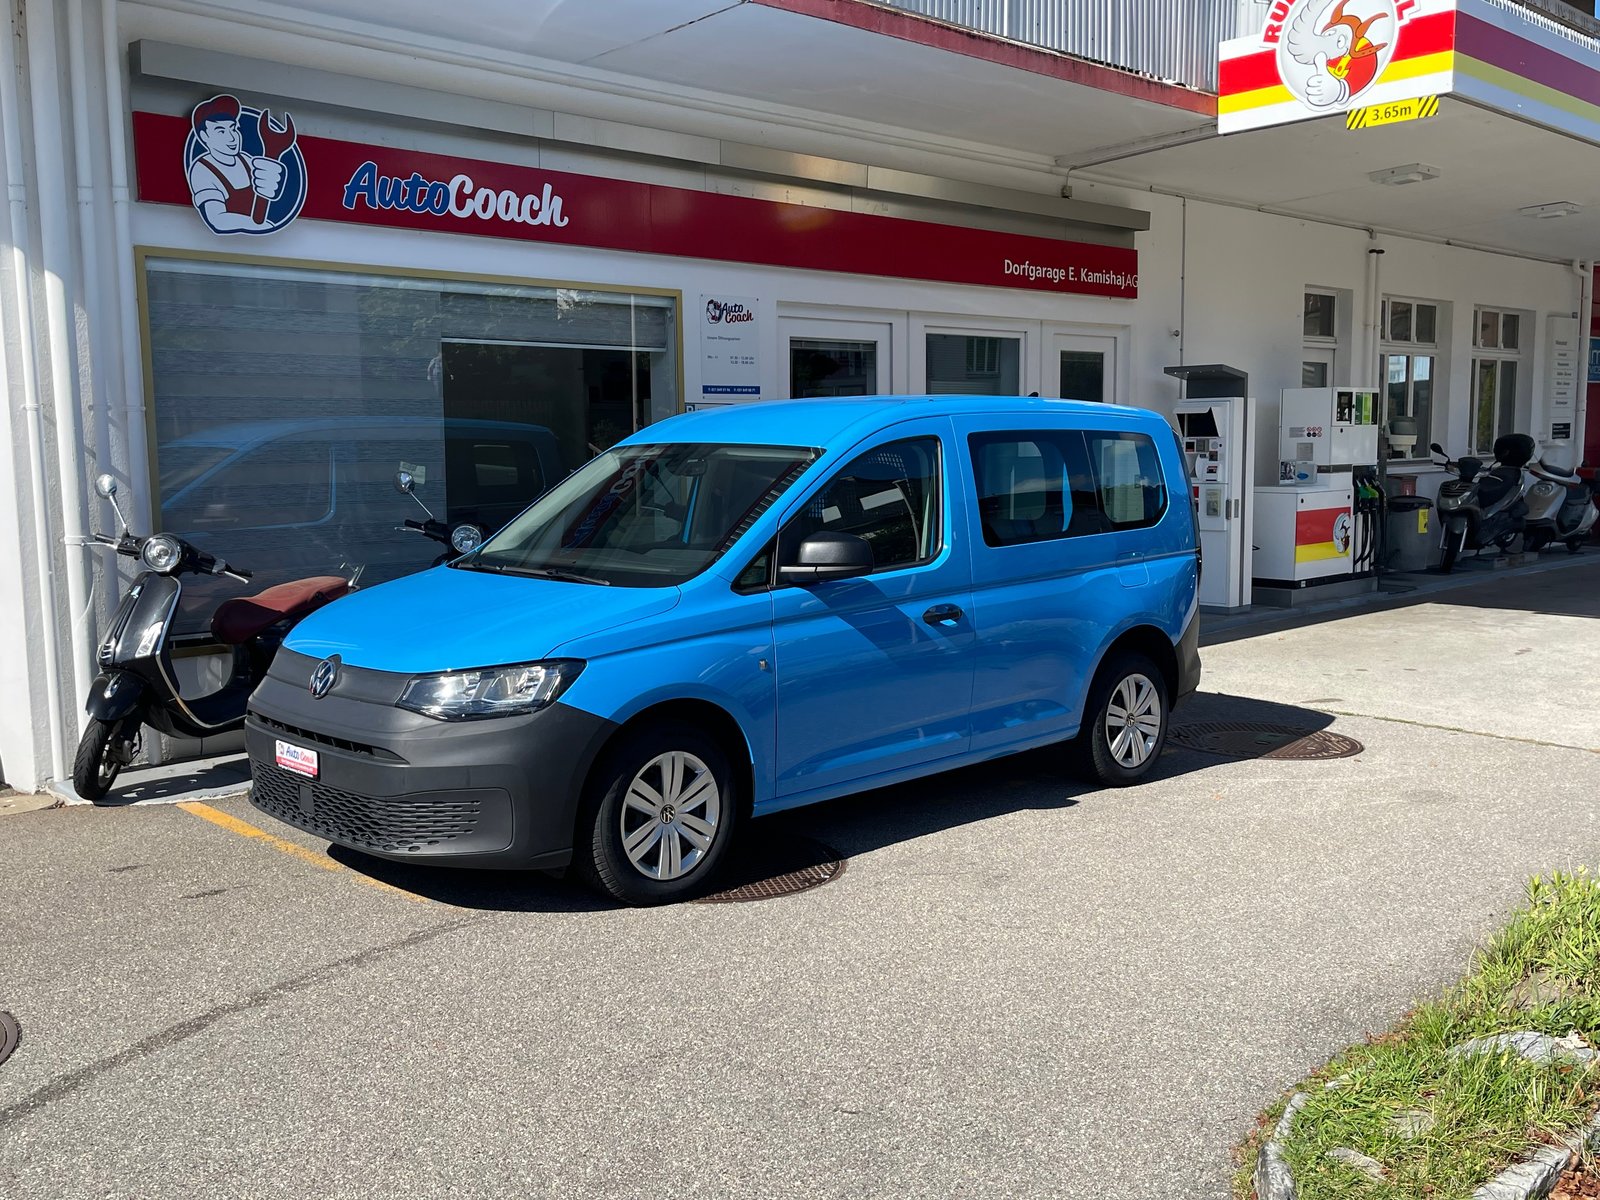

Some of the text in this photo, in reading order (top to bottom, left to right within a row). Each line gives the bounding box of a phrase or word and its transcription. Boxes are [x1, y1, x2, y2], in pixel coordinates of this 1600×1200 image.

[1372, 104, 1412, 122] 3.65m
[1003, 258, 1066, 283] Dorfgarage
[1068, 266, 1078, 281] E.
[721, 302, 744, 314] Auto
[725, 309, 754, 323] Coach
[285, 745, 300, 761] Auto
